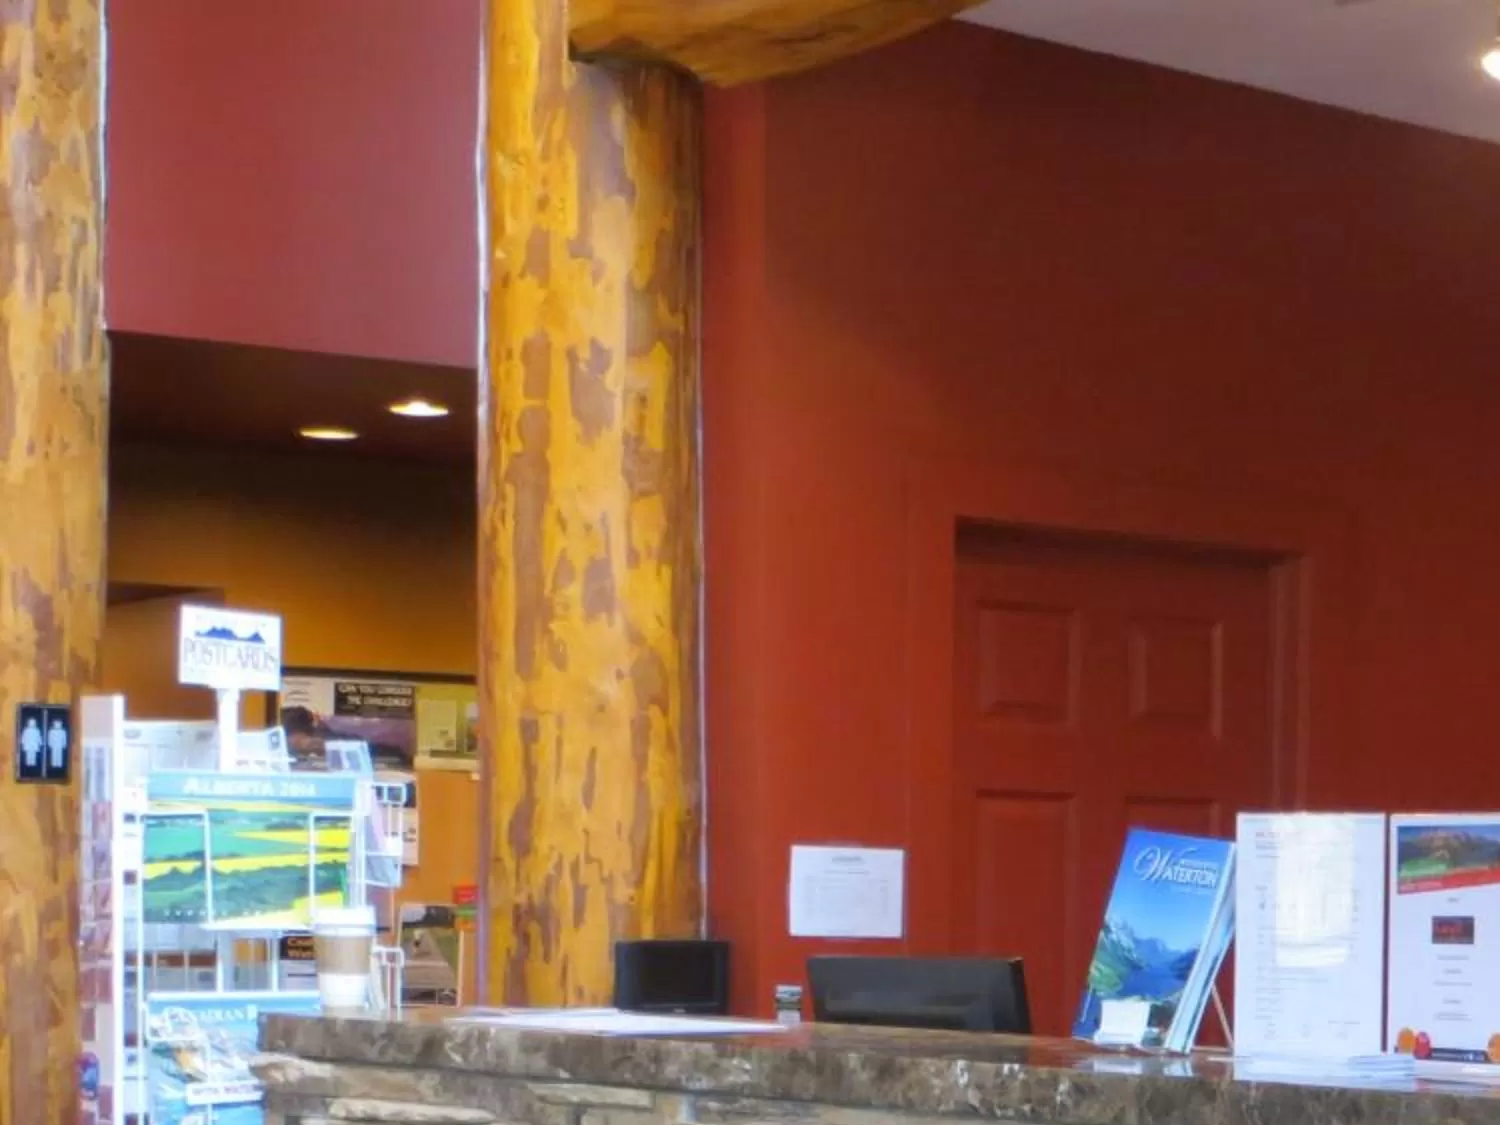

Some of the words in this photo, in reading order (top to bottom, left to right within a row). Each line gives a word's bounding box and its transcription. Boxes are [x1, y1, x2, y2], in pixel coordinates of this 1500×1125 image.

[184, 637, 279, 672] POSTCARDS
[183, 776, 275, 797] ALBERTA
[1134, 846, 1217, 888] WATERTON
